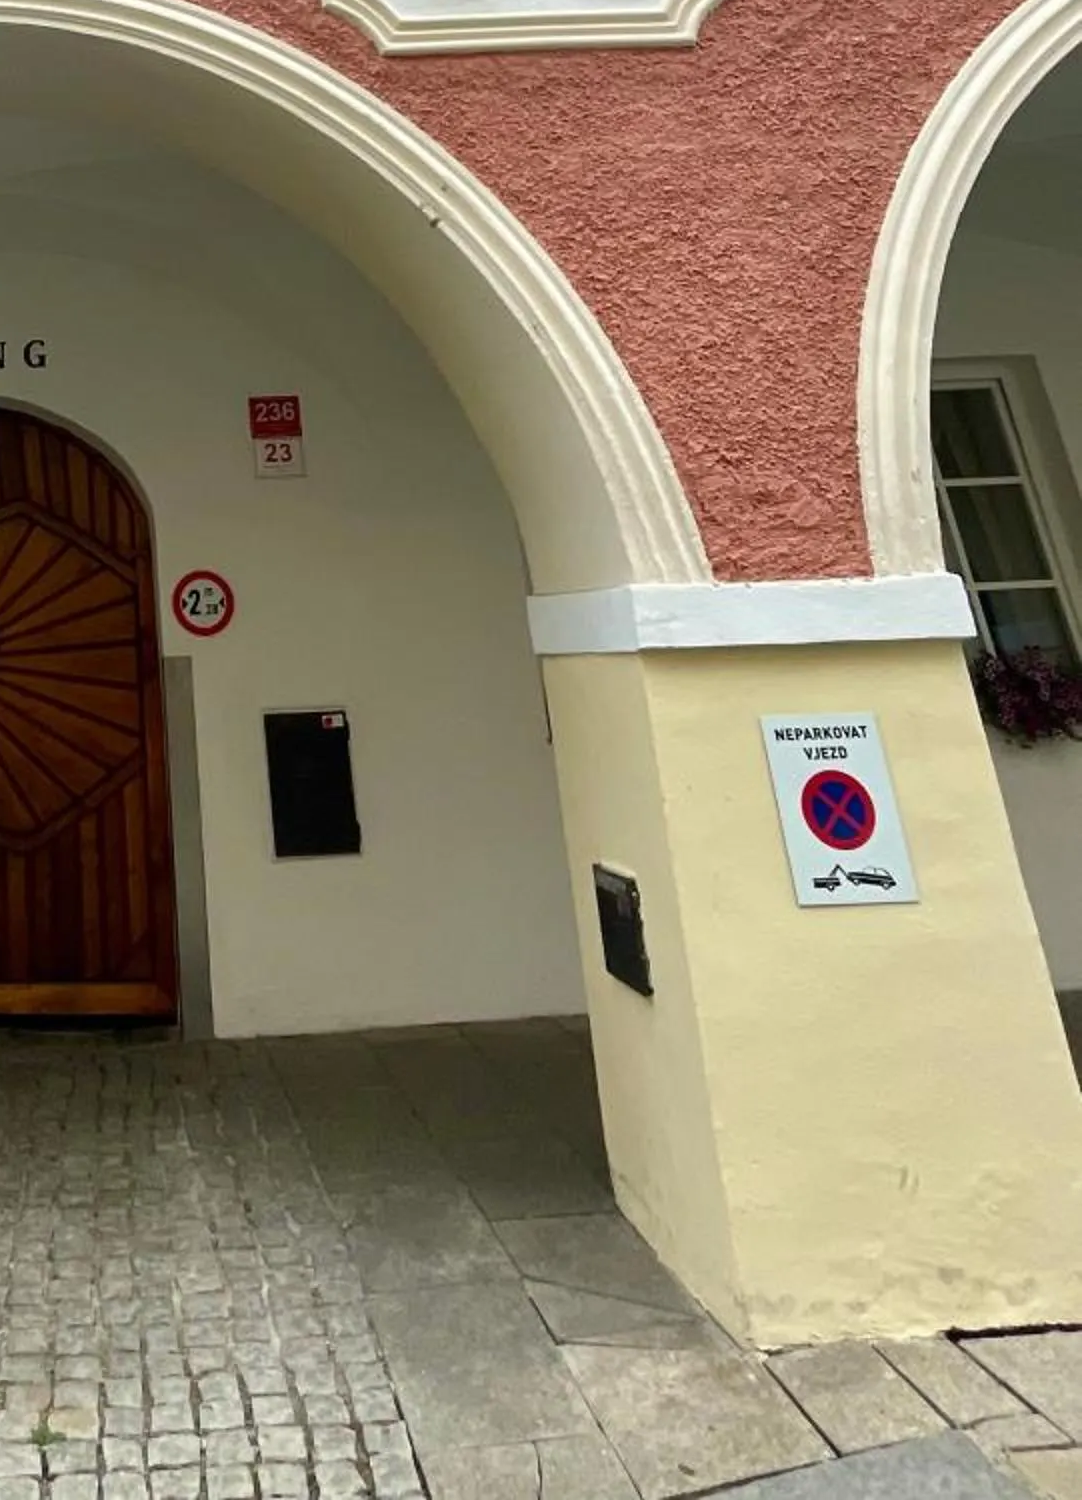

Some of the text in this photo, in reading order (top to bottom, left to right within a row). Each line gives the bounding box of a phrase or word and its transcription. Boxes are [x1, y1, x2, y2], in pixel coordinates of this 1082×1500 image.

[255, 402, 295, 422] 236
[264, 443, 293, 463] 23
[188, 589, 202, 616] 2
[774, 725, 868, 742] NEPARKOVAT
[803, 746, 848, 760] VJEZD
